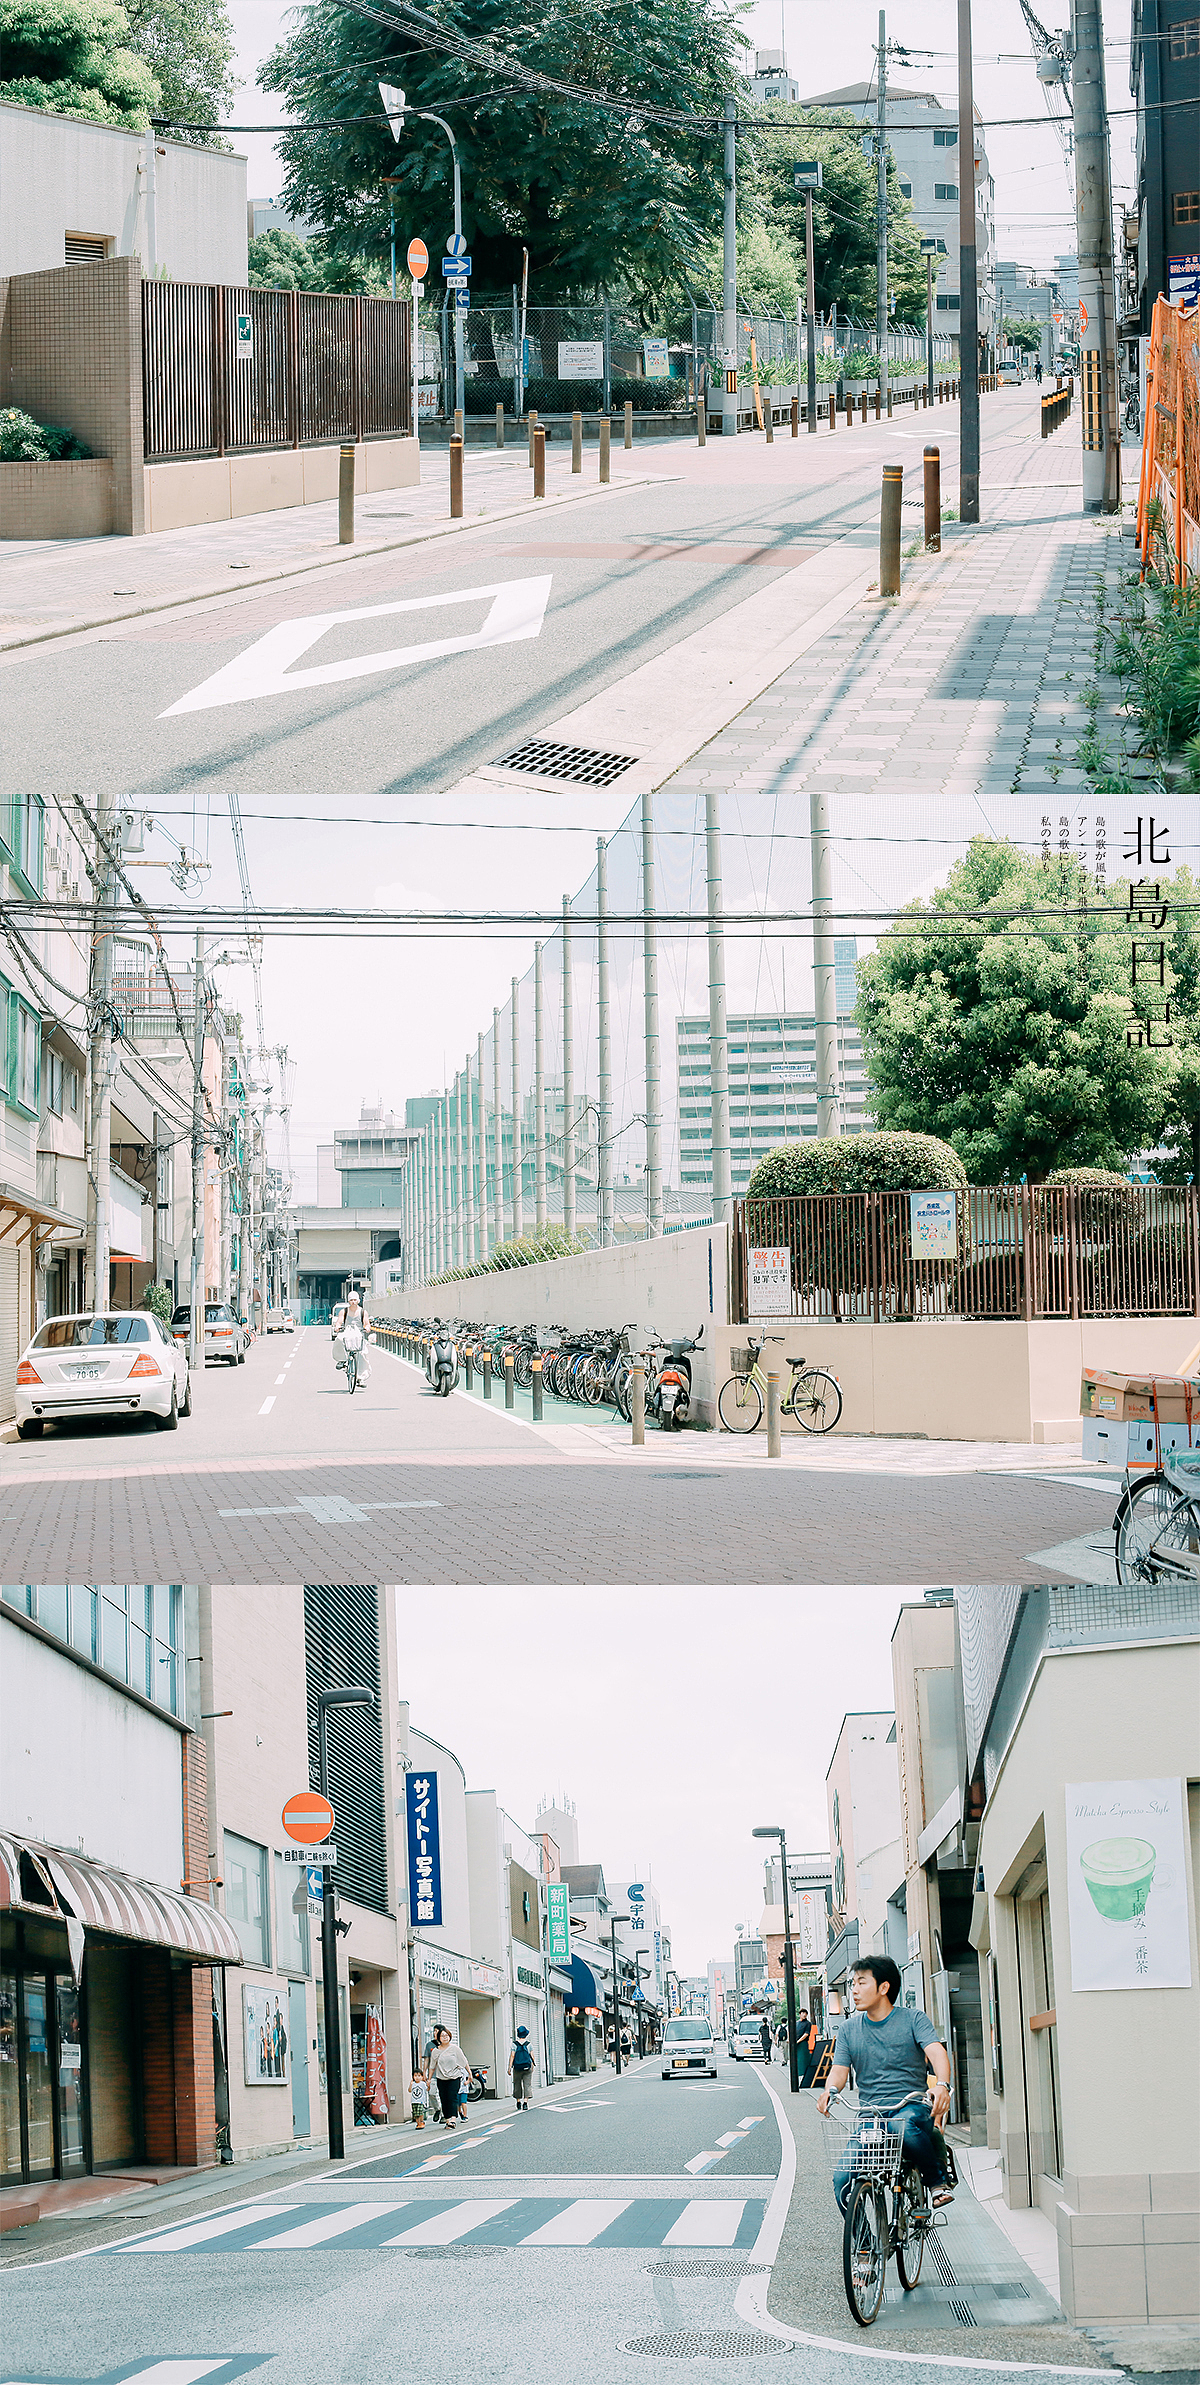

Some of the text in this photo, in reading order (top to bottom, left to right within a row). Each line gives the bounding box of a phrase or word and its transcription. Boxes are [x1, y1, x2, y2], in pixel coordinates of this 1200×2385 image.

[411, 390, 436, 407] 禁止
[753, 1251, 786, 1268] 警告
[753, 1274, 788, 1284] 犯罪です
[1074, 1800, 1171, 1818] Matcha Espresso Style
[413, 1779, 435, 1920] サイトー写真館
[550, 1887, 566, 1954] 新町薬局
[629, 1903, 645, 1930] 宇治
[803, 1926, 813, 1959] ヤマサン
[1132, 1887, 1149, 1975] 手摘み一番茶
